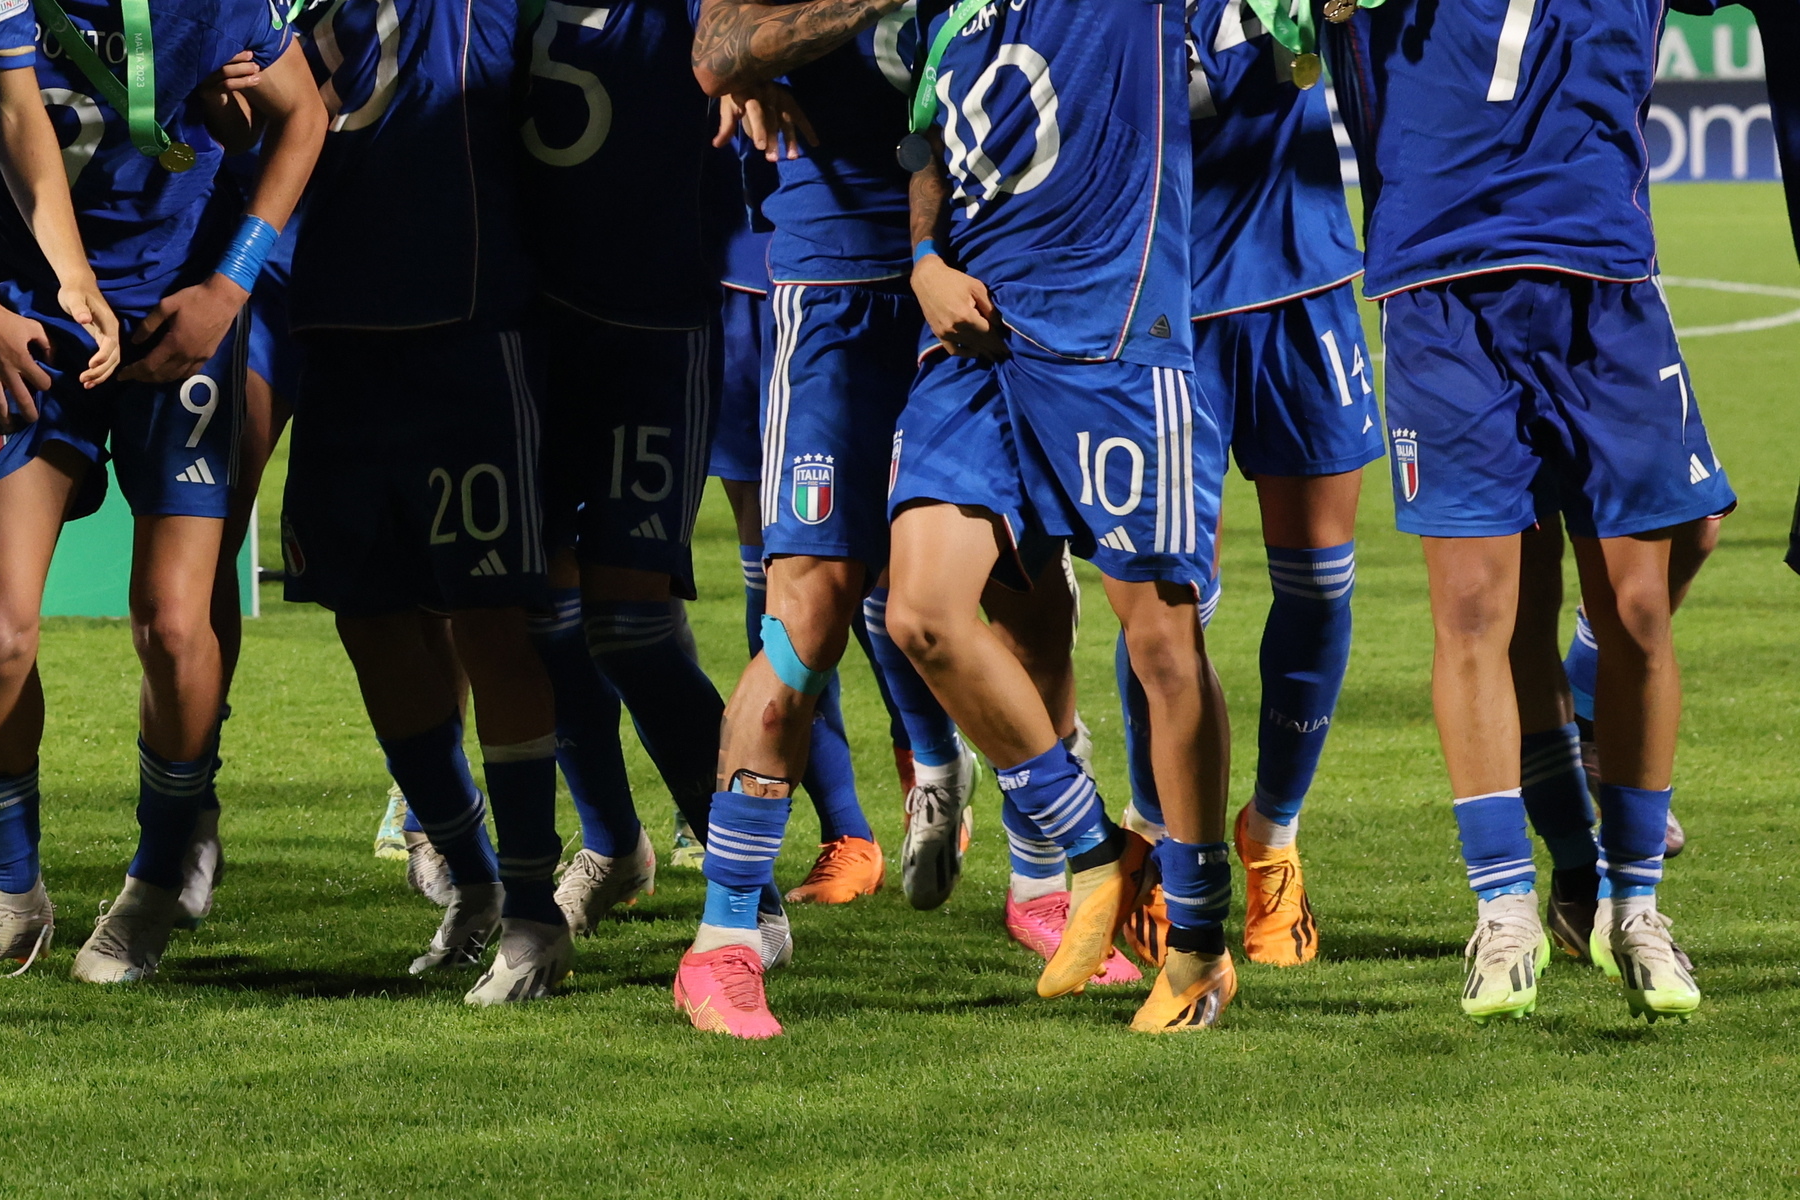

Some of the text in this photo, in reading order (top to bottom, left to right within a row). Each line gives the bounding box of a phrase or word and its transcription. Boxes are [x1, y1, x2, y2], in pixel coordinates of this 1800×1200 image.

[133, 32, 146, 89] MALTA 2023
[935, 44, 1060, 220] 10
[1320, 329, 1371, 407] 14
[1659, 362, 1689, 445] 7
[179, 374, 220, 448] 9
[610, 424, 674, 502] 15
[797, 469, 830, 481] ITALIA
[1077, 430, 1144, 517] 10
[428, 463, 509, 546] 20
[1268, 707, 1330, 733] ITALIA
